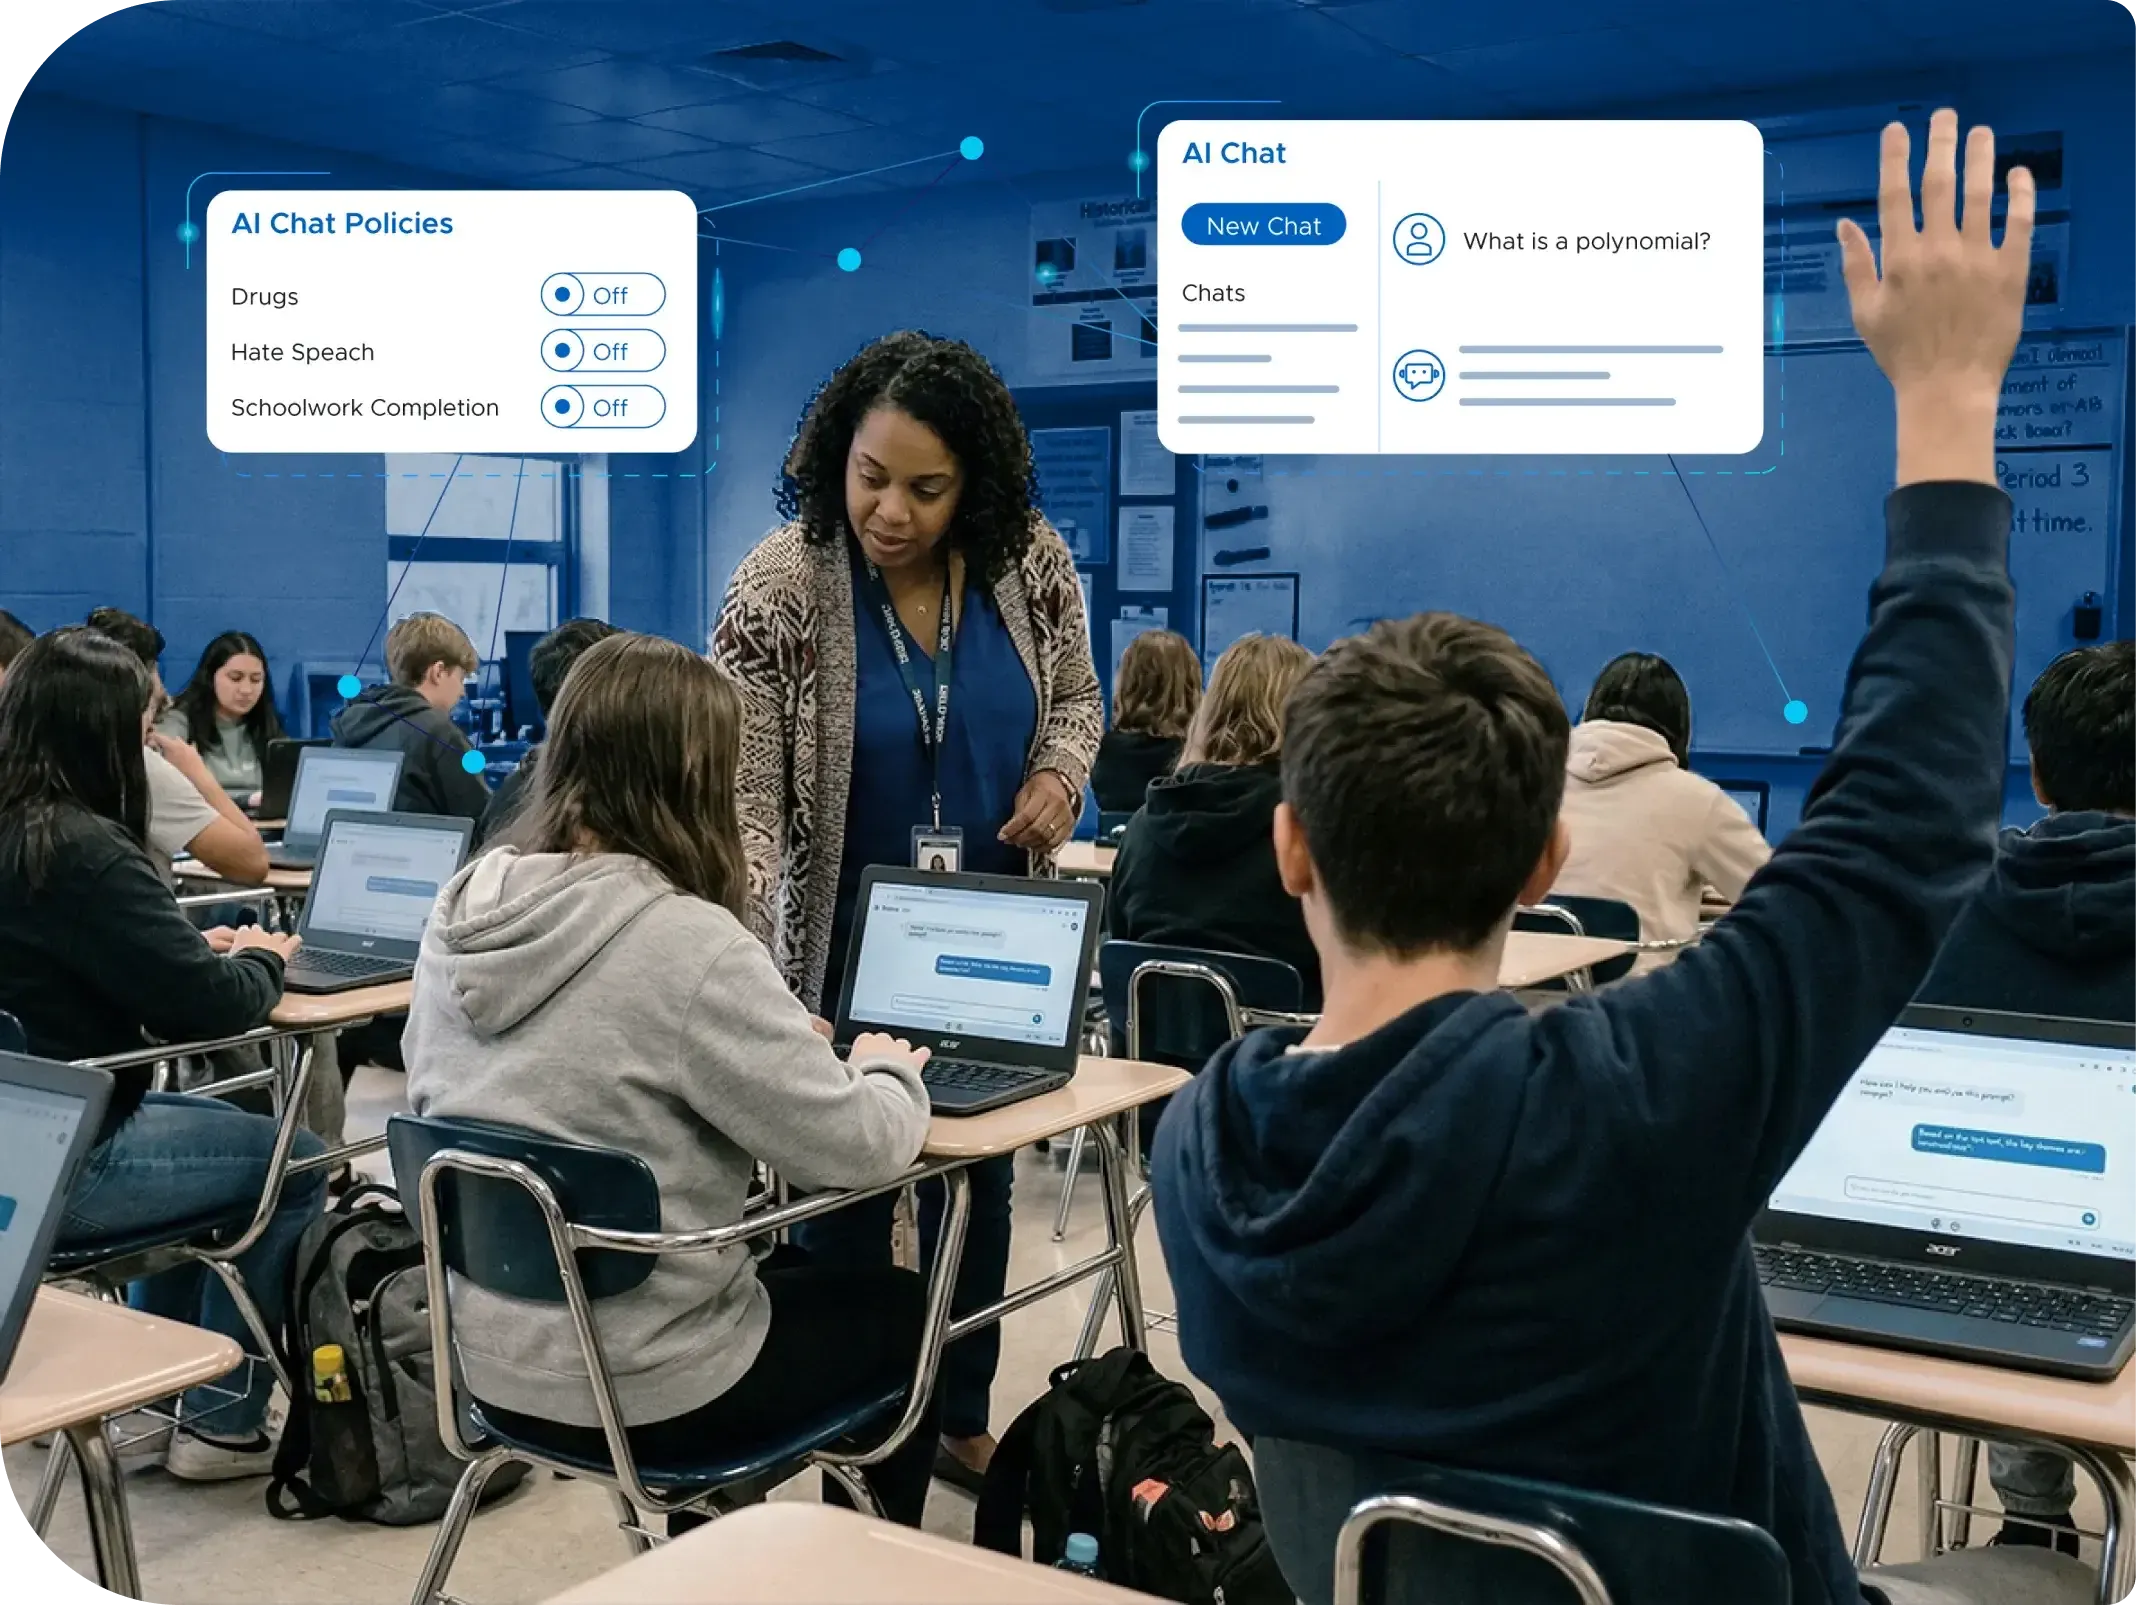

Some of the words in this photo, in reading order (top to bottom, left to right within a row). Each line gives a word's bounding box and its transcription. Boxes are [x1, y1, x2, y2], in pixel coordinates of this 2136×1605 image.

[1996, 460, 2061, 489] Period
[2070, 461, 2091, 487] 3
[2031, 506, 2094, 534] time.
[1925, 1243, 1963, 1258] acer
